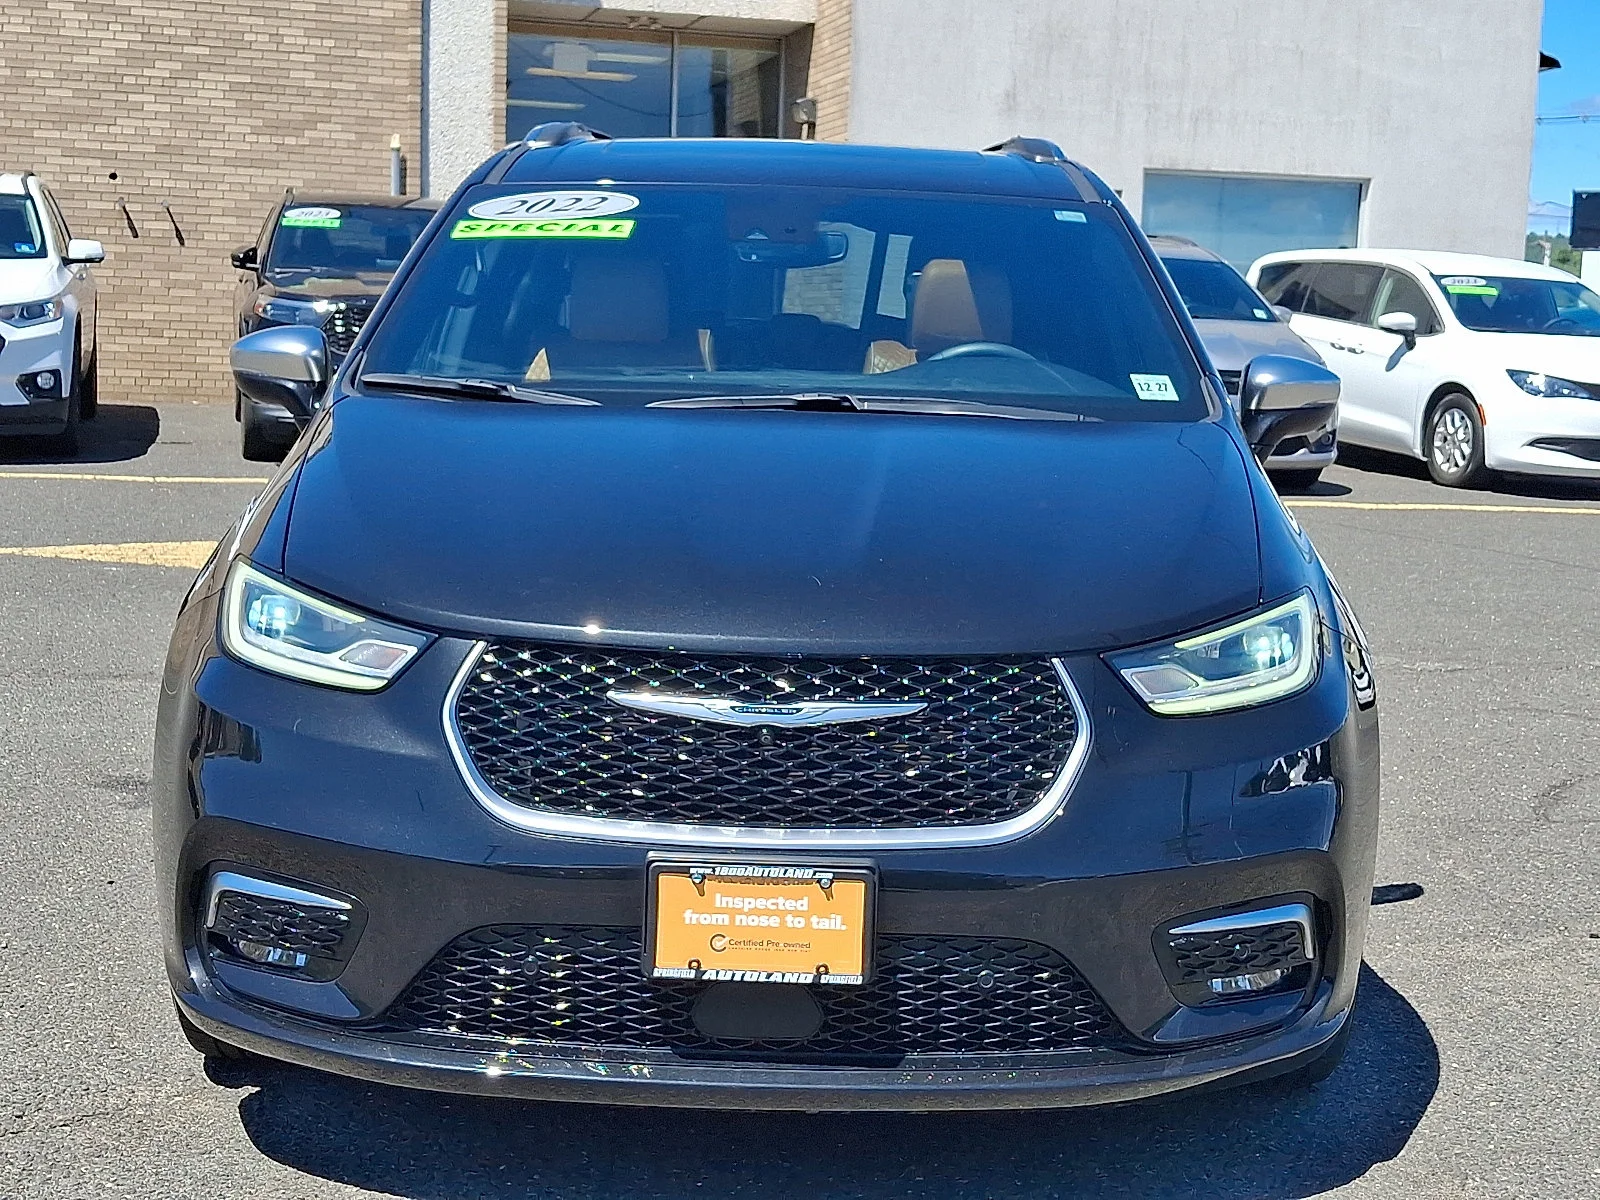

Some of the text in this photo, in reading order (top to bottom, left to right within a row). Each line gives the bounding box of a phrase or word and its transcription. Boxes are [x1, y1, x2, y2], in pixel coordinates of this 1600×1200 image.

[495, 196, 610, 216] 2022
[458, 222, 627, 234] SPECIAL
[1137, 382, 1168, 392] 12 27
[714, 893, 809, 912] Inspected
[683, 909, 847, 930] from nose to tail.
[728, 938, 764, 947] Certified
[701, 969, 814, 984] AUTOLAND
